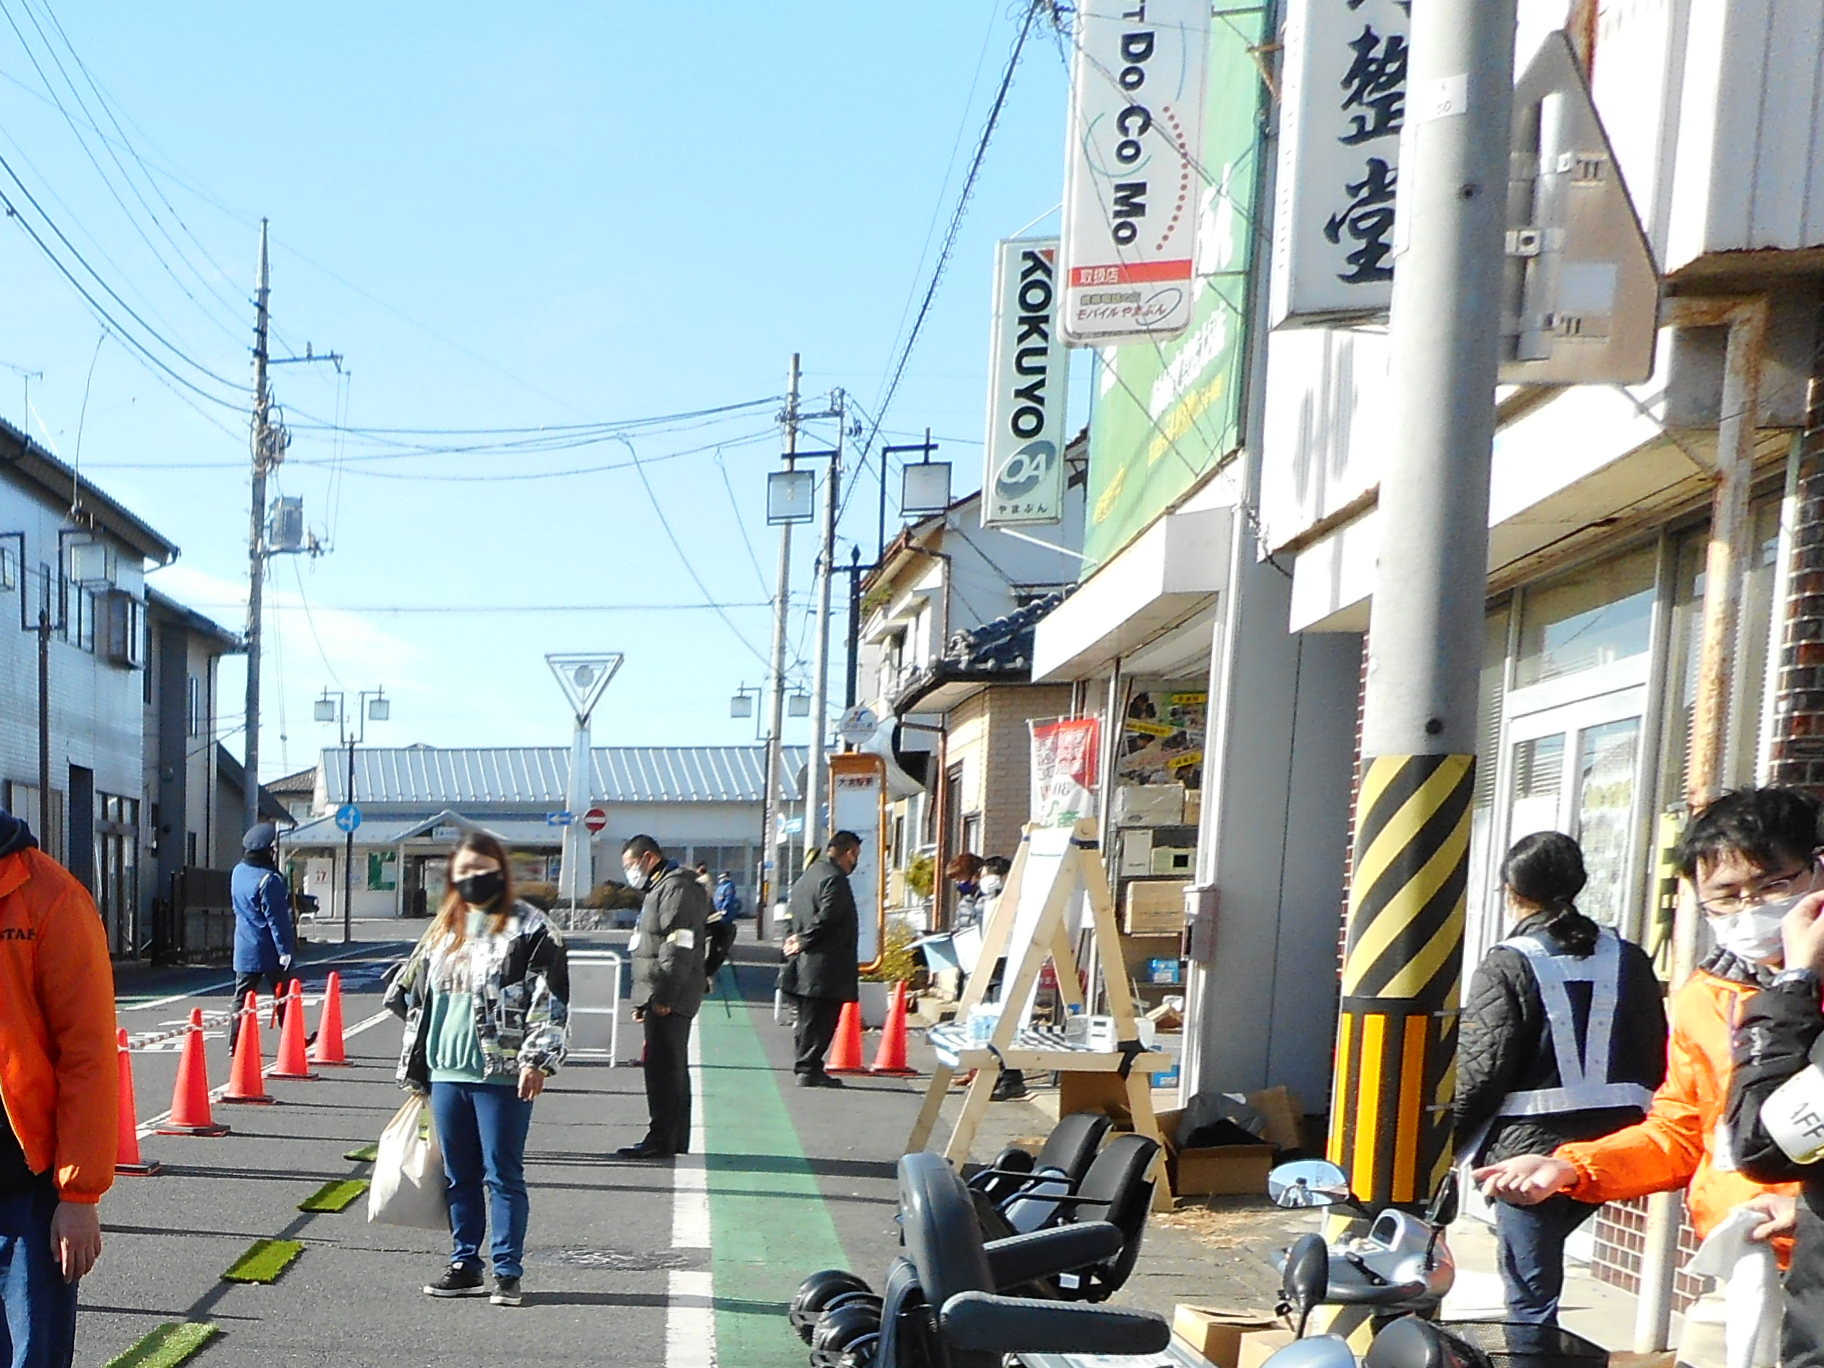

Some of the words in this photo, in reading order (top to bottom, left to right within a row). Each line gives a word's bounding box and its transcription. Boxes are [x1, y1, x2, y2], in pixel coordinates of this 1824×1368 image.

[1324, 0, 1412, 284] 整堂
[1079, 267, 1120, 284] 取扱店
[1009, 249, 1055, 440] KOKUYO
[1000, 453, 1048, 485] OA
